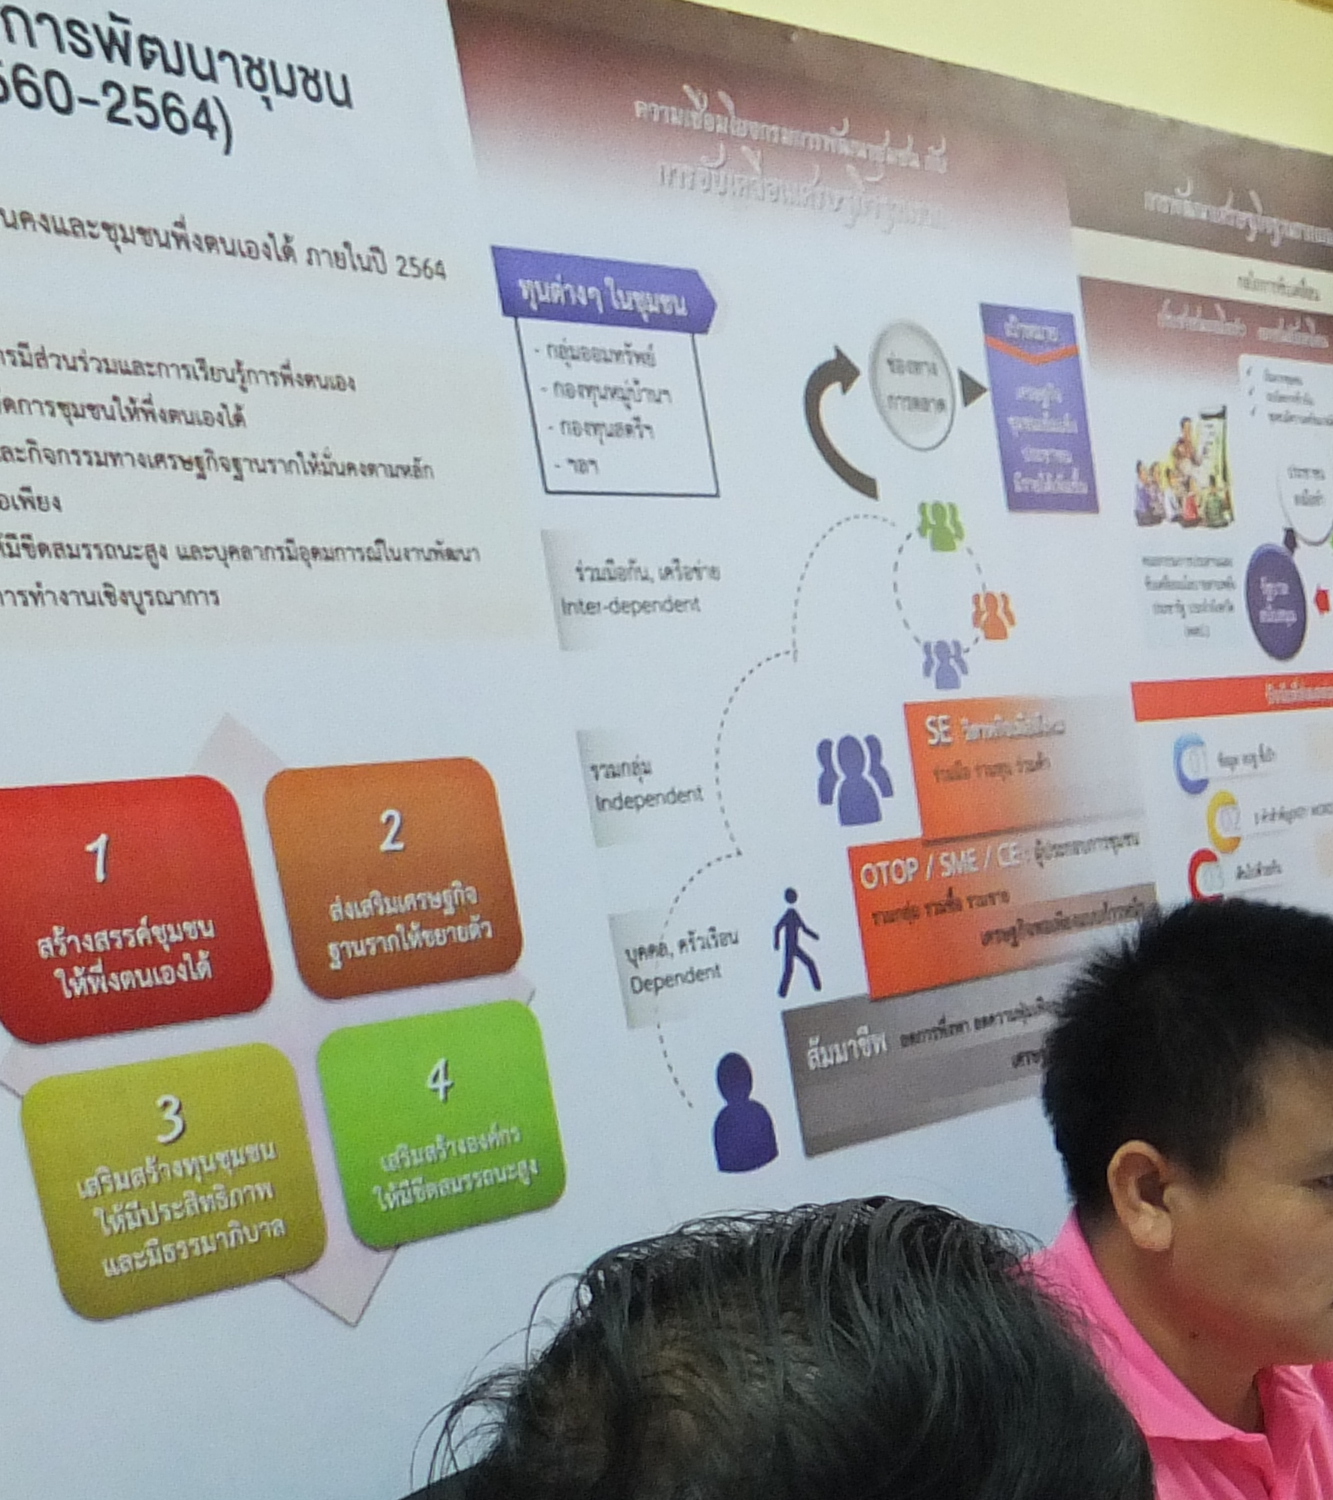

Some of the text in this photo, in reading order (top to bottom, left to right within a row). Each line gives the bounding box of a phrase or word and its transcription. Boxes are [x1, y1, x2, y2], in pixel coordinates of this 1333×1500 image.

[0, 4, 355, 110] การพัฒนาชุมชน
[305, 241, 388, 276] ภายในปี
[396, 254, 447, 281] 2564
[560, 595, 702, 618] Inter-dependent
[925, 713, 954, 746] SE
[595, 783, 705, 814] Independent
[379, 807, 406, 854] 2
[85, 831, 111, 884] 1
[860, 856, 920, 890] OTOP
[940, 846, 979, 878] SME
[629, 963, 722, 996] Dependent
[425, 1056, 455, 1102] 4
[154, 1092, 188, 1145] 3
